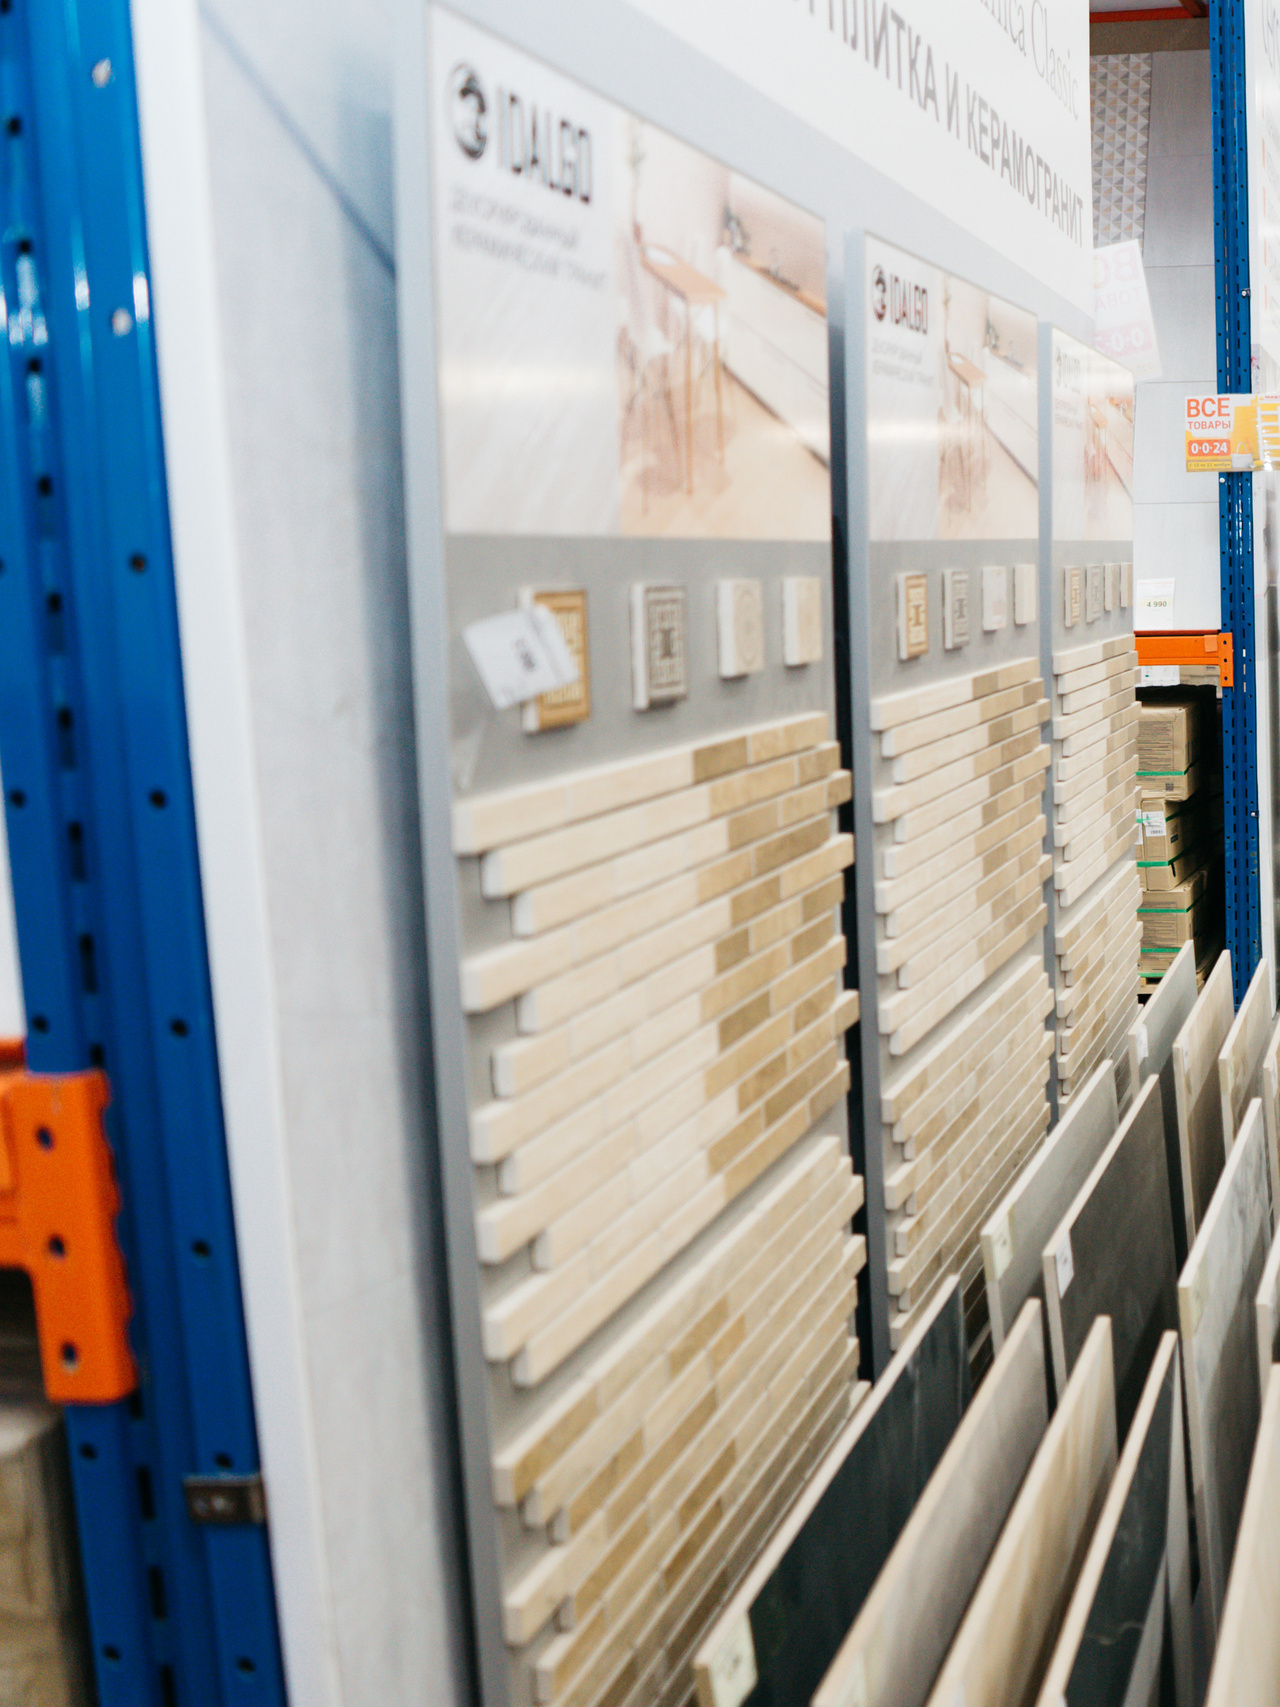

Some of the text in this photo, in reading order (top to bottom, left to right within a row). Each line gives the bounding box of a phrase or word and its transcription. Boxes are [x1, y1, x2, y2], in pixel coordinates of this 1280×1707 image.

[1031, 0, 1079, 121] Classic
[497, 84, 593, 205] IDALGO
[946, 62, 960, 140] И
[966, 83, 1084, 249] КЕРАМОГРАНИТ
[890, 273, 929, 335] IDALGO
[1187, 397, 1230, 418] ВСЕ
[1188, 420, 1231, 430] ТОВАРЫ
